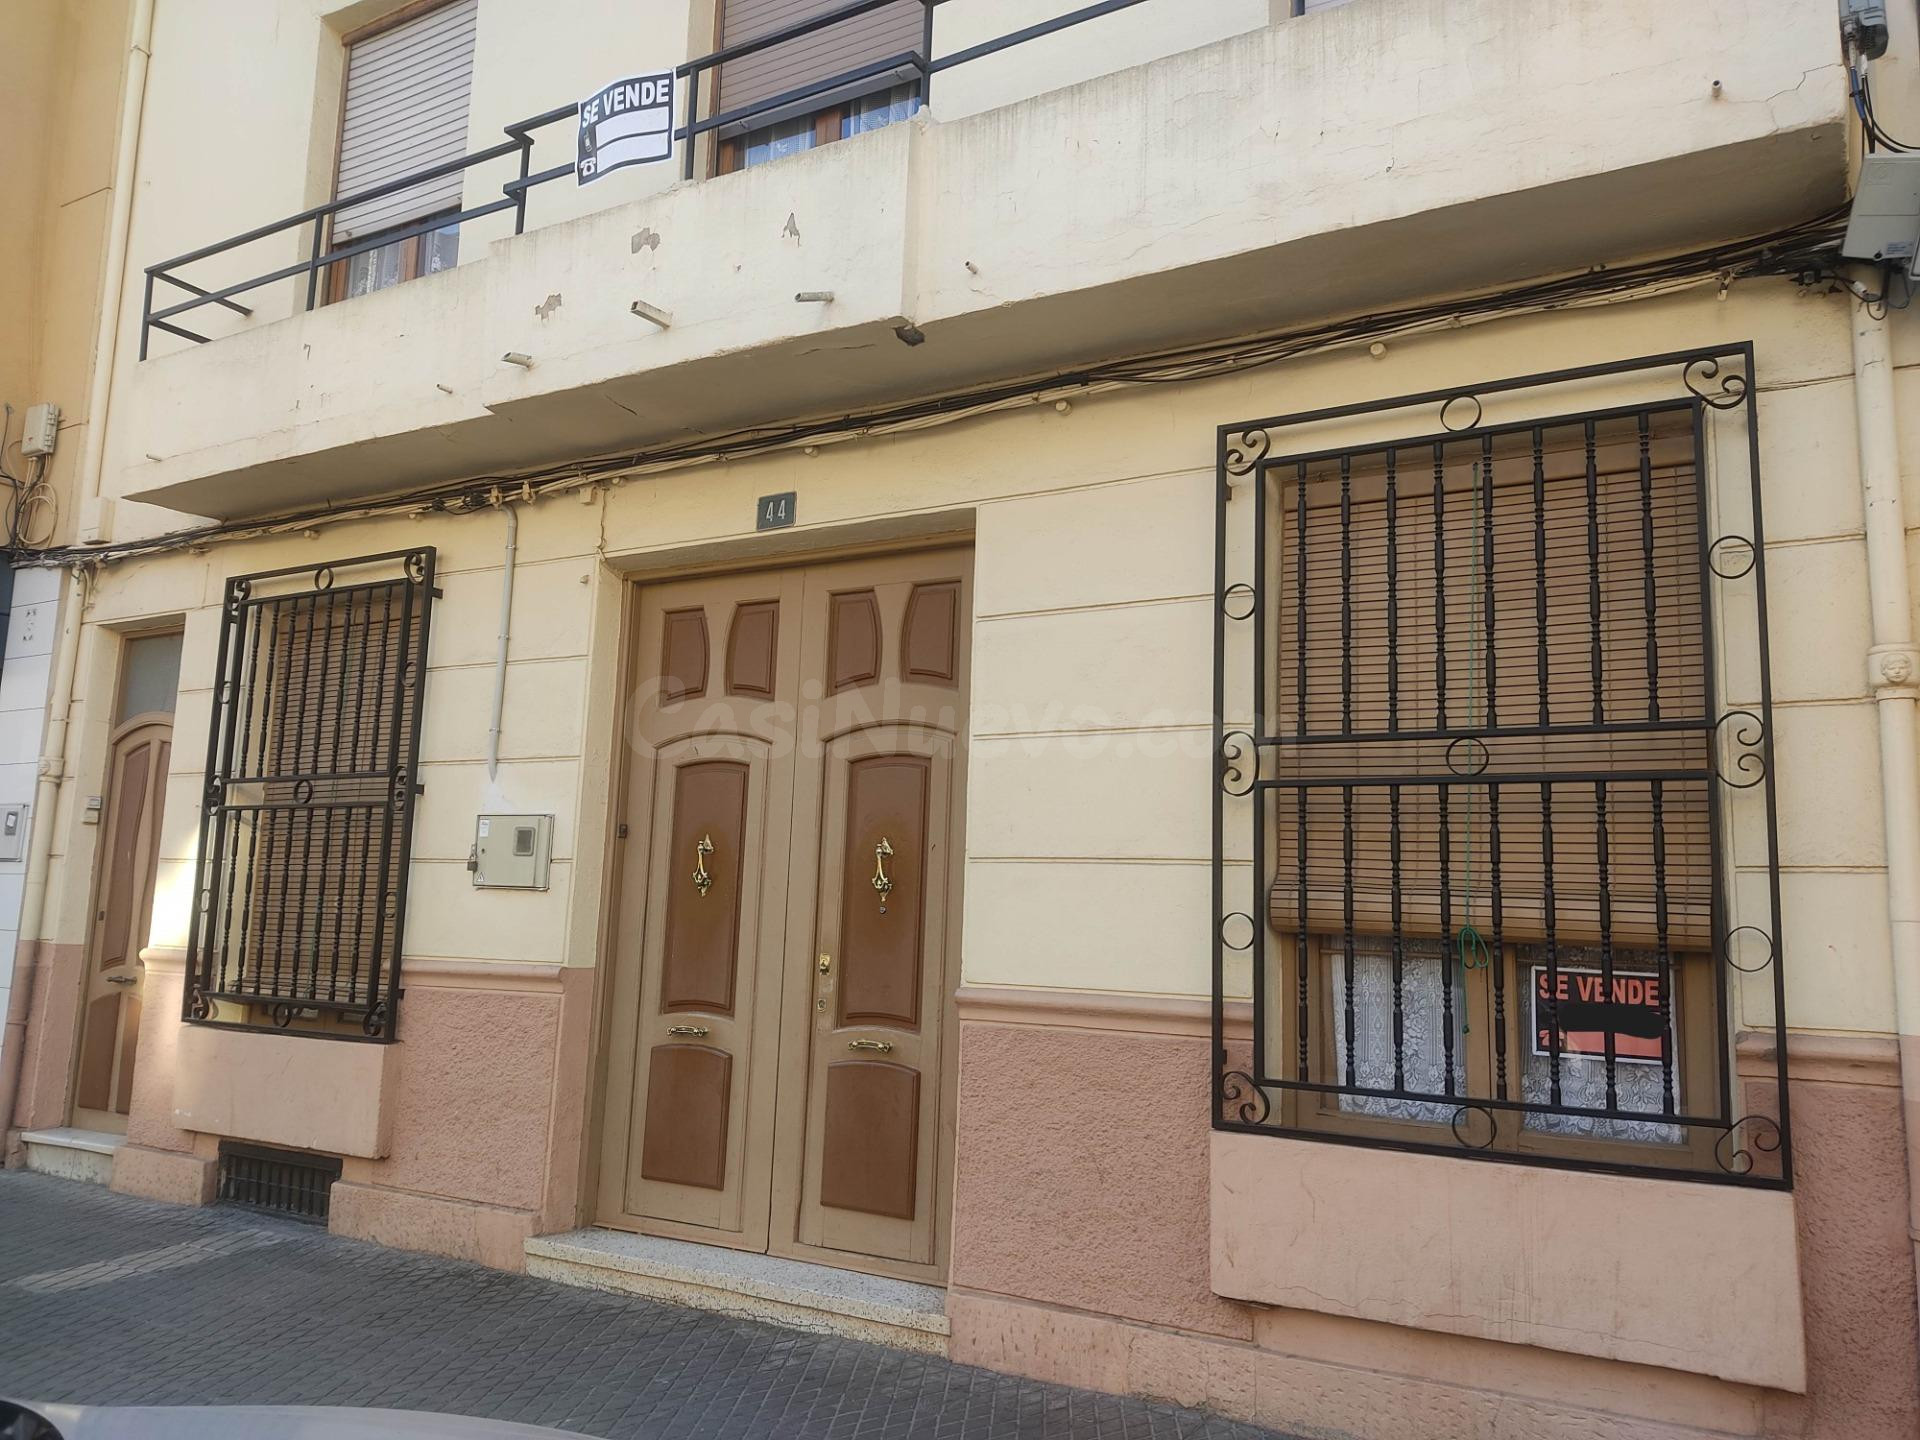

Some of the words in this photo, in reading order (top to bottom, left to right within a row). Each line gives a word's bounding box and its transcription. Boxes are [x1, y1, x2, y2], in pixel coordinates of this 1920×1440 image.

[582, 98, 600, 128] SE
[603, 78, 670, 116] VENDE
[765, 499, 786, 522] 44
[1539, 973, 1569, 1000] SE
[1575, 975, 1661, 1006] VENDE
